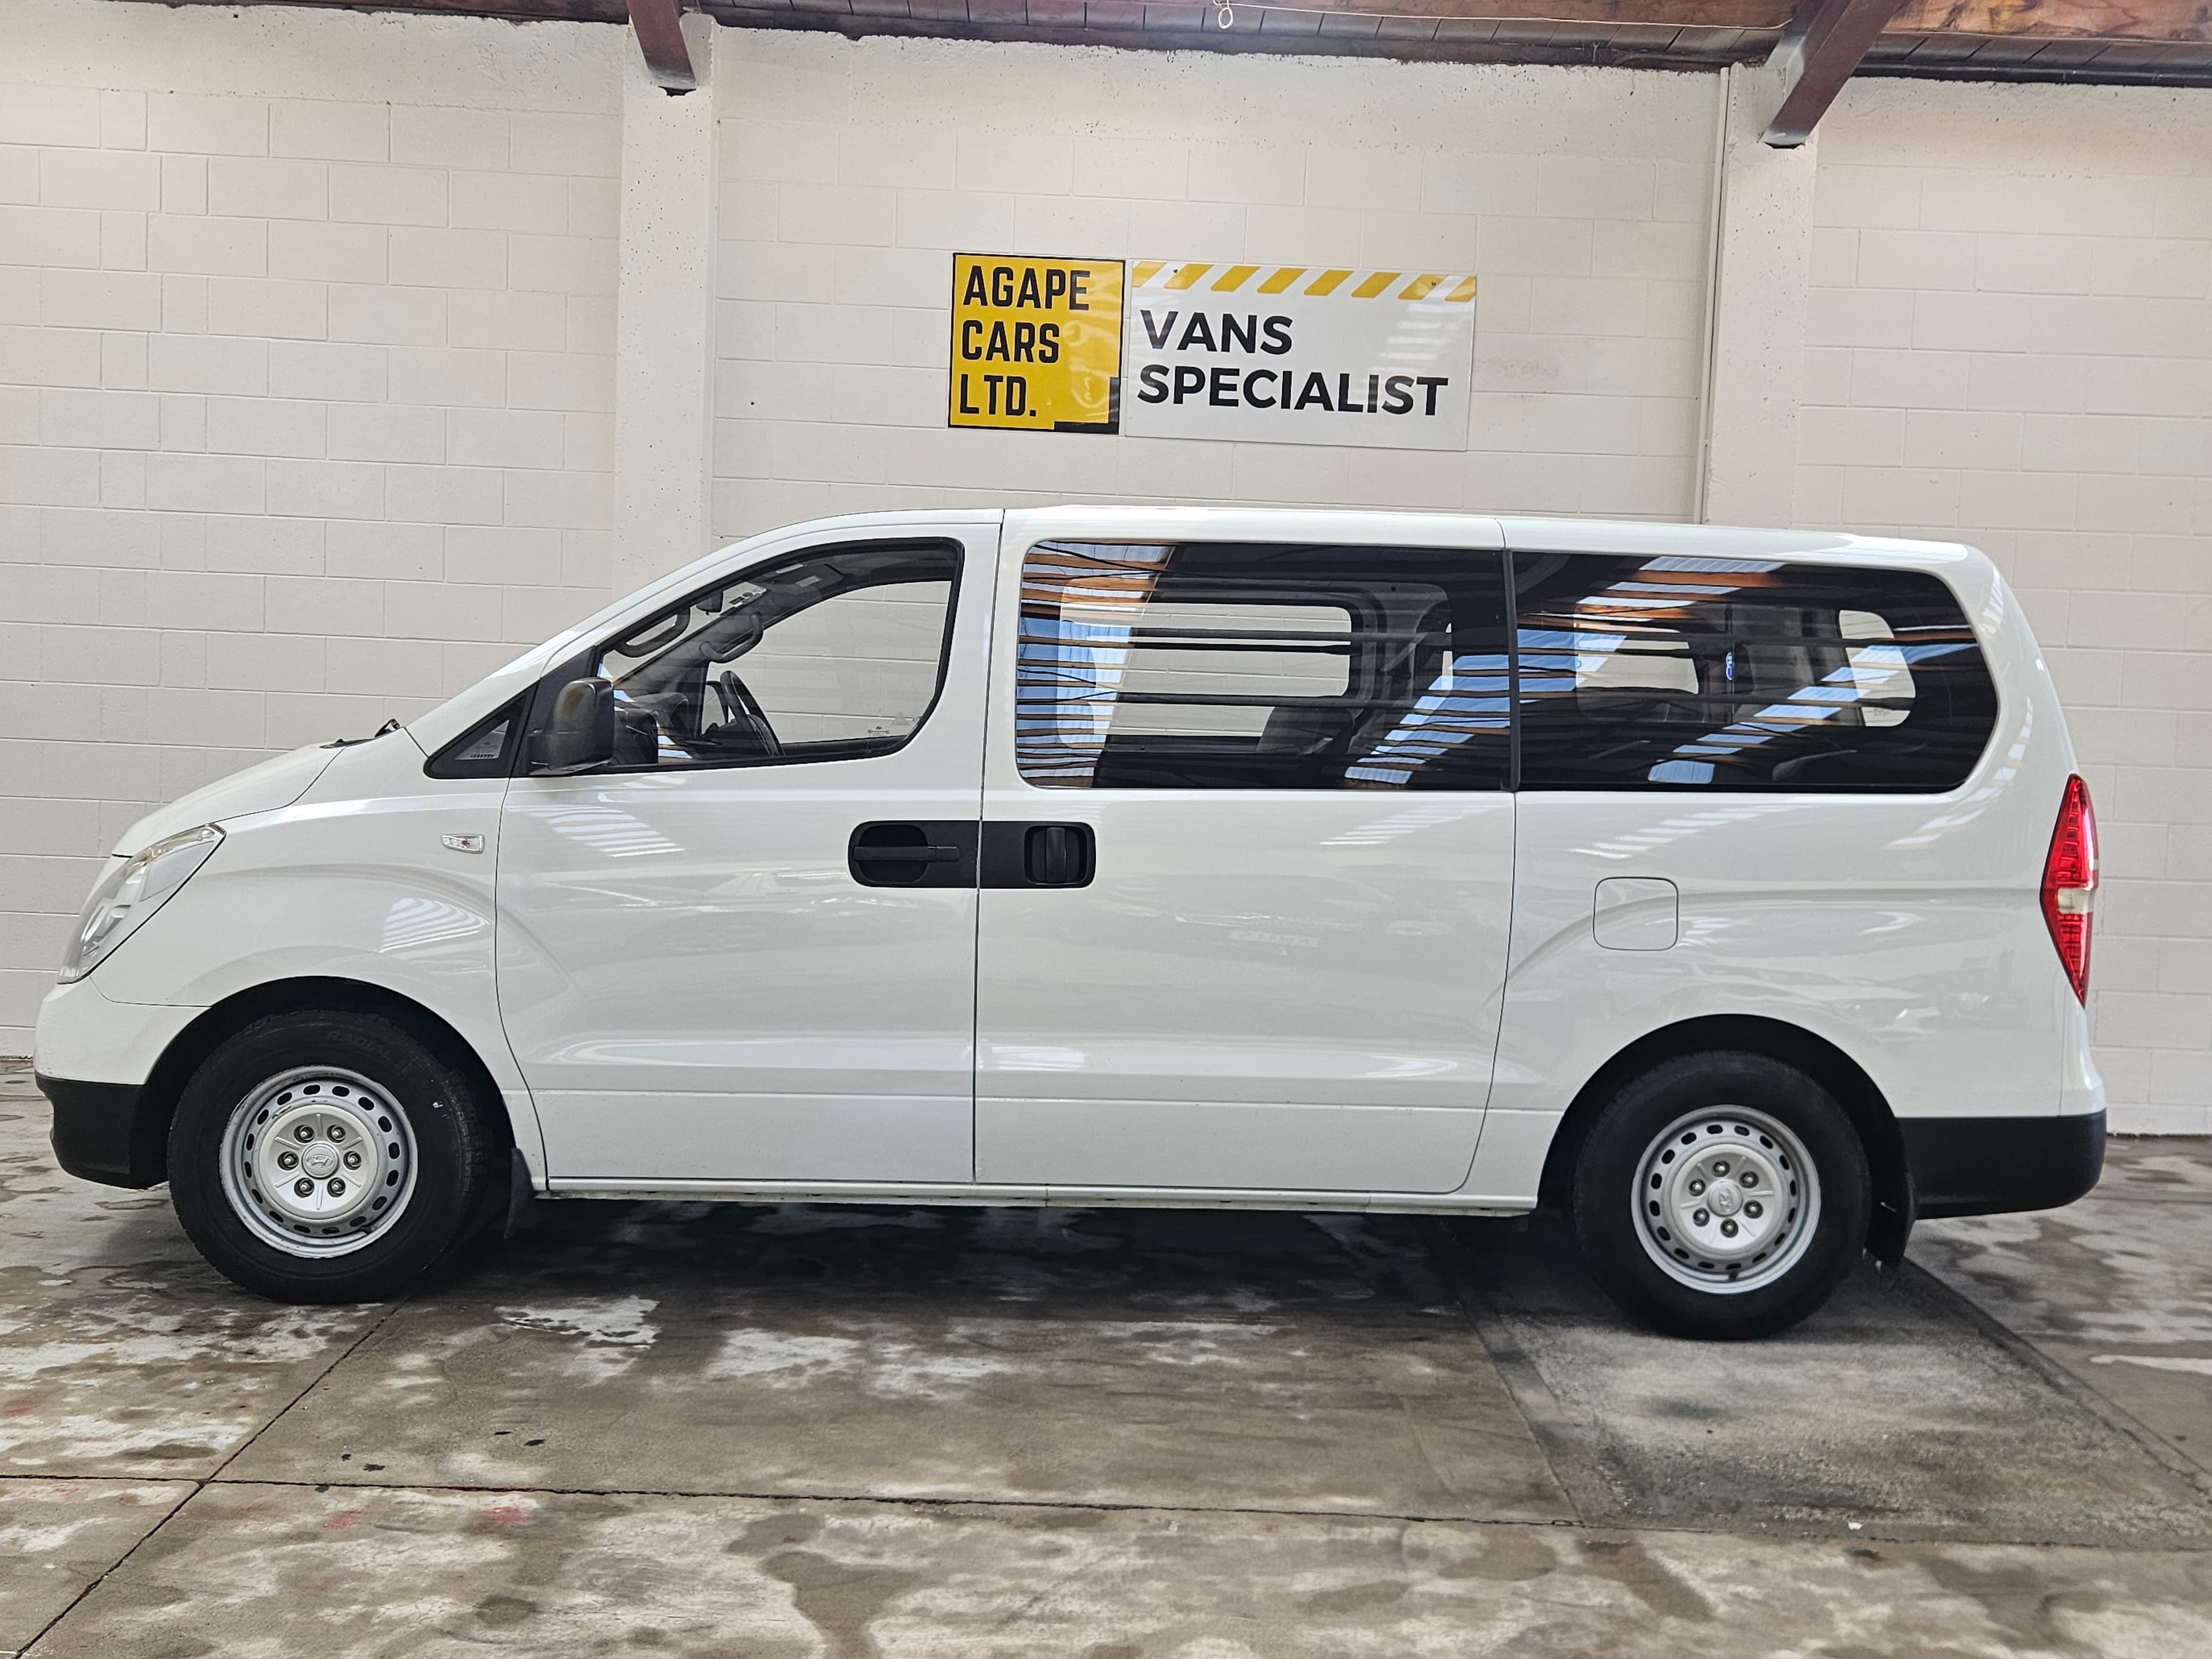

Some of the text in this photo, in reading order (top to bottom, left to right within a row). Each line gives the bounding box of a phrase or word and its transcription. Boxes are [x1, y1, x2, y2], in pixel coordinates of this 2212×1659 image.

[963, 265, 1091, 311] AGAPE
[961, 320, 1060, 364] CARS
[1140, 309, 1294, 356] VANS
[960, 374, 1037, 418] LTD.
[1137, 364, 1449, 416] SPECIALIST
